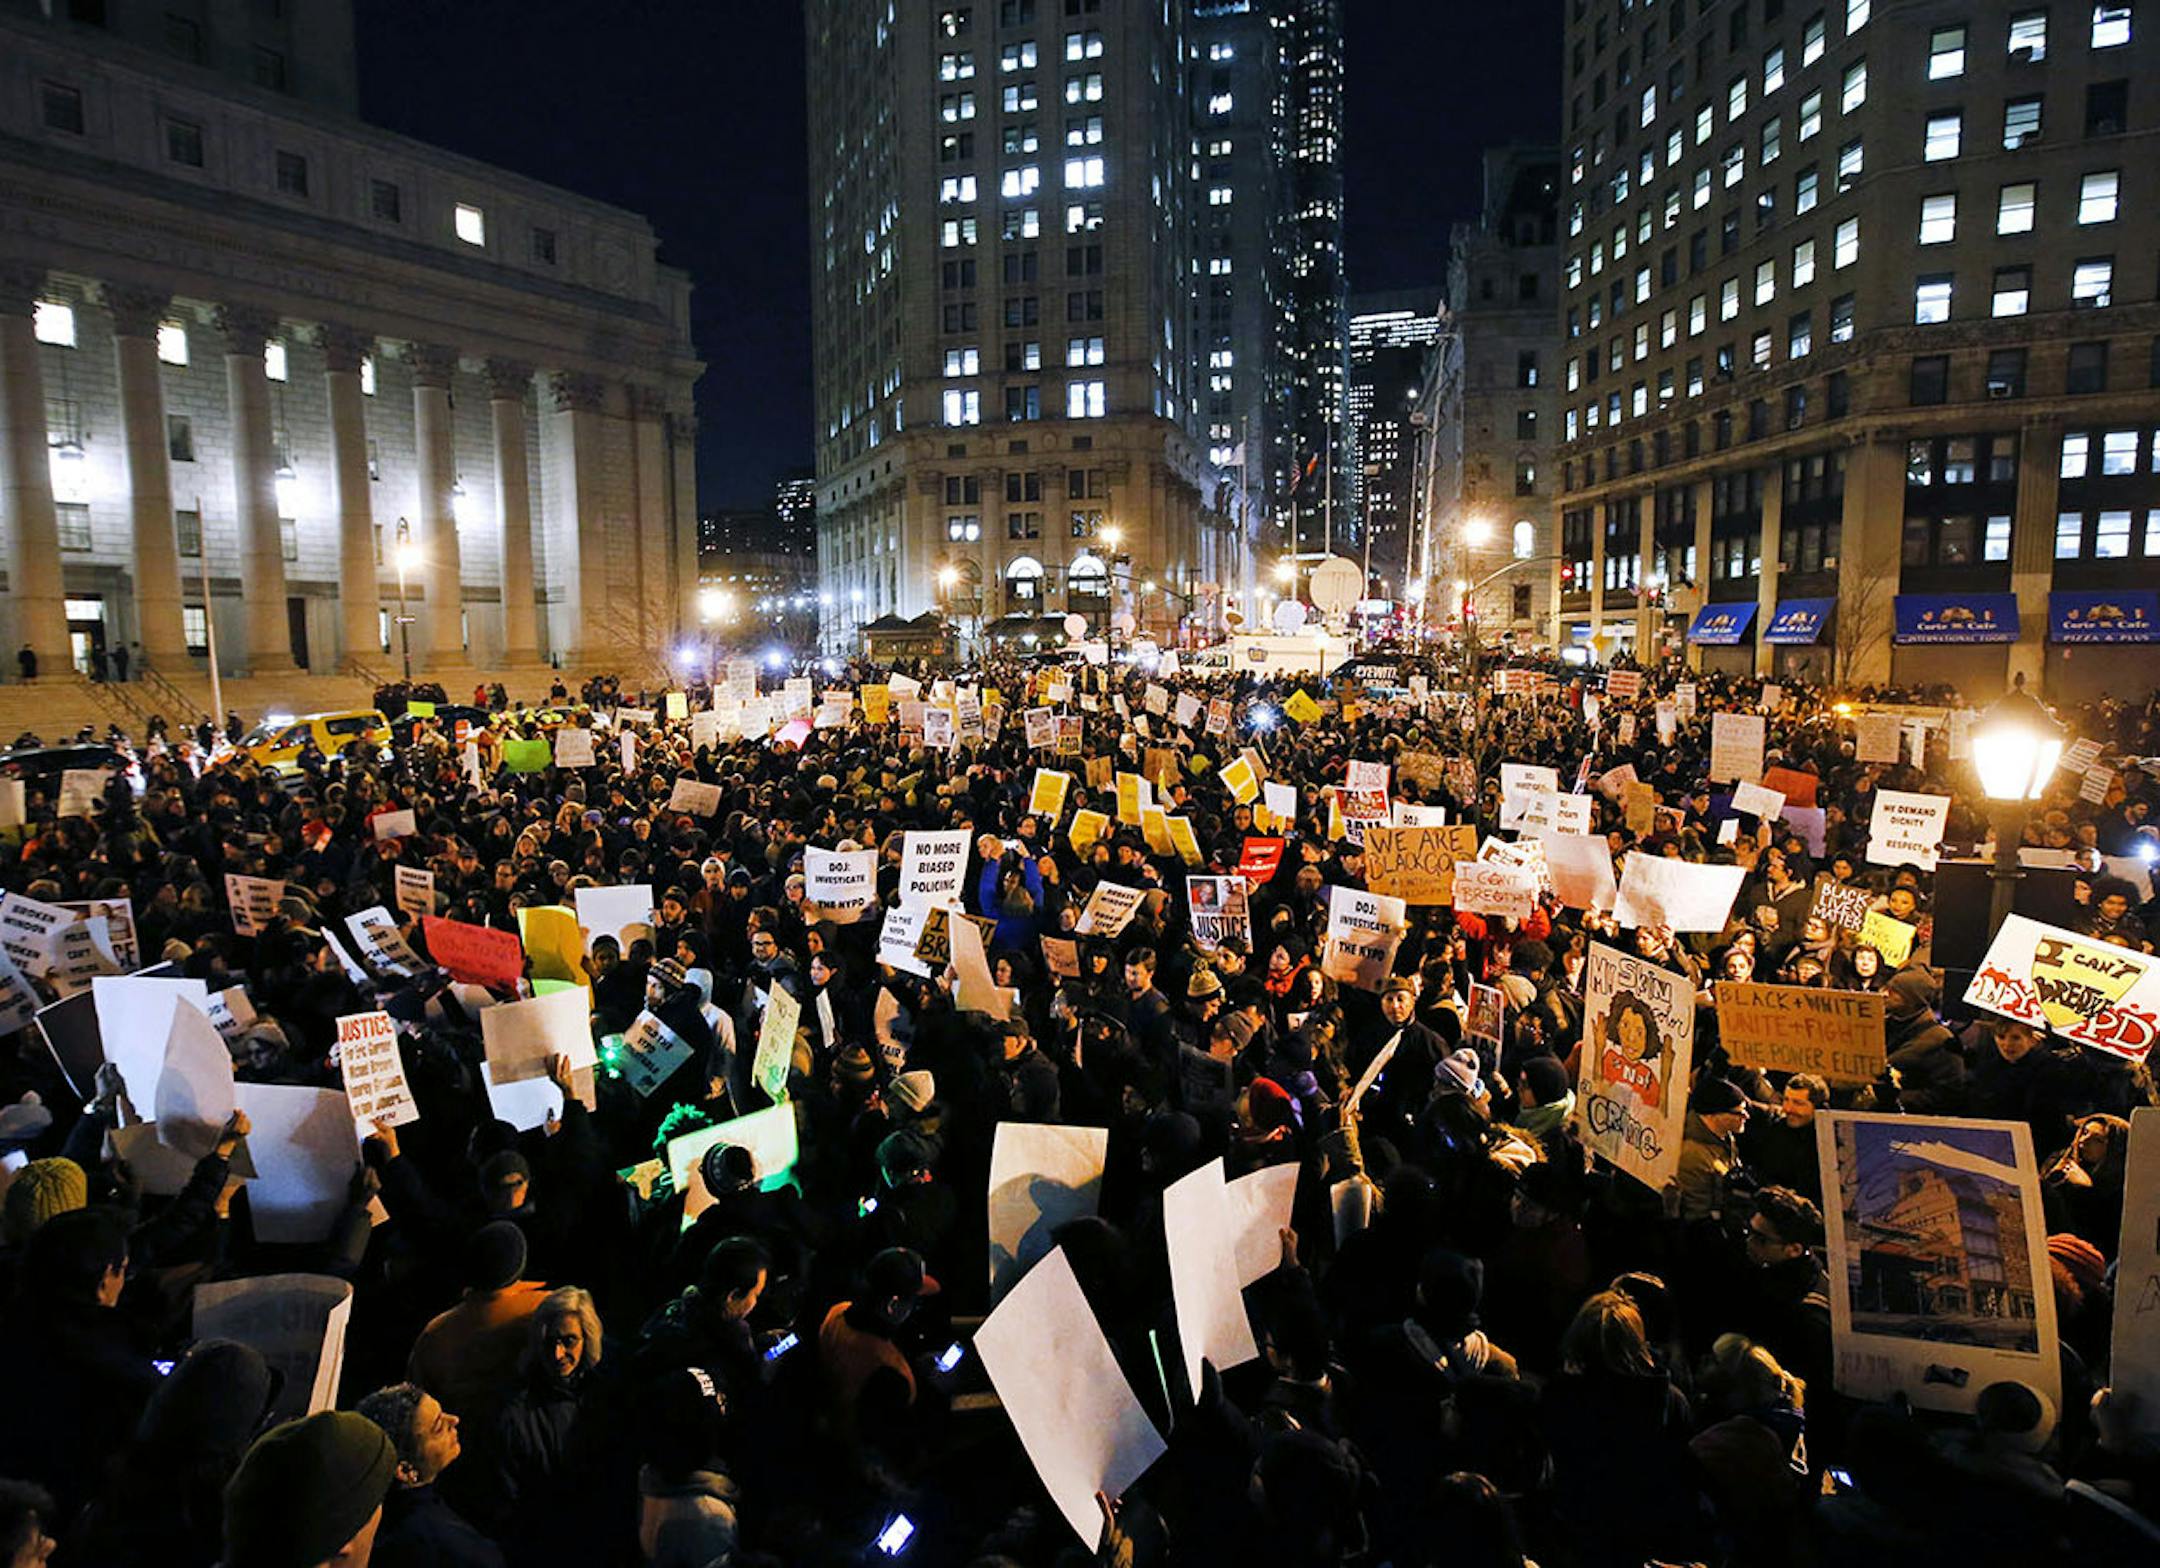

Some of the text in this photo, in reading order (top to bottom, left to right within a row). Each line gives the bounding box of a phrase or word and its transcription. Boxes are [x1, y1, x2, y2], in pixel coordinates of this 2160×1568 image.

[2062, 633, 2099, 642] PIZZA
[1897, 805, 1937, 818] DEMAND
[1890, 816, 1925, 828] DIGNITY
[915, 842, 961, 855] NO MORE
[1368, 829, 1409, 853] WE
[1417, 827, 1464, 858] ARE
[1886, 840, 1923, 852] RESPECT
[918, 861, 955, 873] BIASED
[815, 874, 865, 885] INVESTIGATE
[910, 878, 956, 893] POLICING
[817, 897, 865, 909] THE NYPD
[1821, 882, 1870, 908] BLACK
[11, 904, 57, 923] BROKEN
[1355, 901, 1377, 916] DOJ:
[1819, 894, 1865, 918] LIVES
[1196, 915, 1250, 941] JUSTICE
[1340, 915, 1390, 934] INVESTIGATE
[1812, 904, 1863, 933] MATTER
[1339, 941, 1386, 962] THE NYPD
[2034, 937, 2143, 980] I CAN'T
[1720, 986, 1791, 1012] BLACK
[1803, 992, 1874, 1019] WHITE
[340, 1015, 394, 1042] JUSTICE
[1724, 1010, 1788, 1037] UNITE
[1804, 1017, 1876, 1048] FIGHT
[1727, 1039, 1883, 1076] THE POWER ELITE
